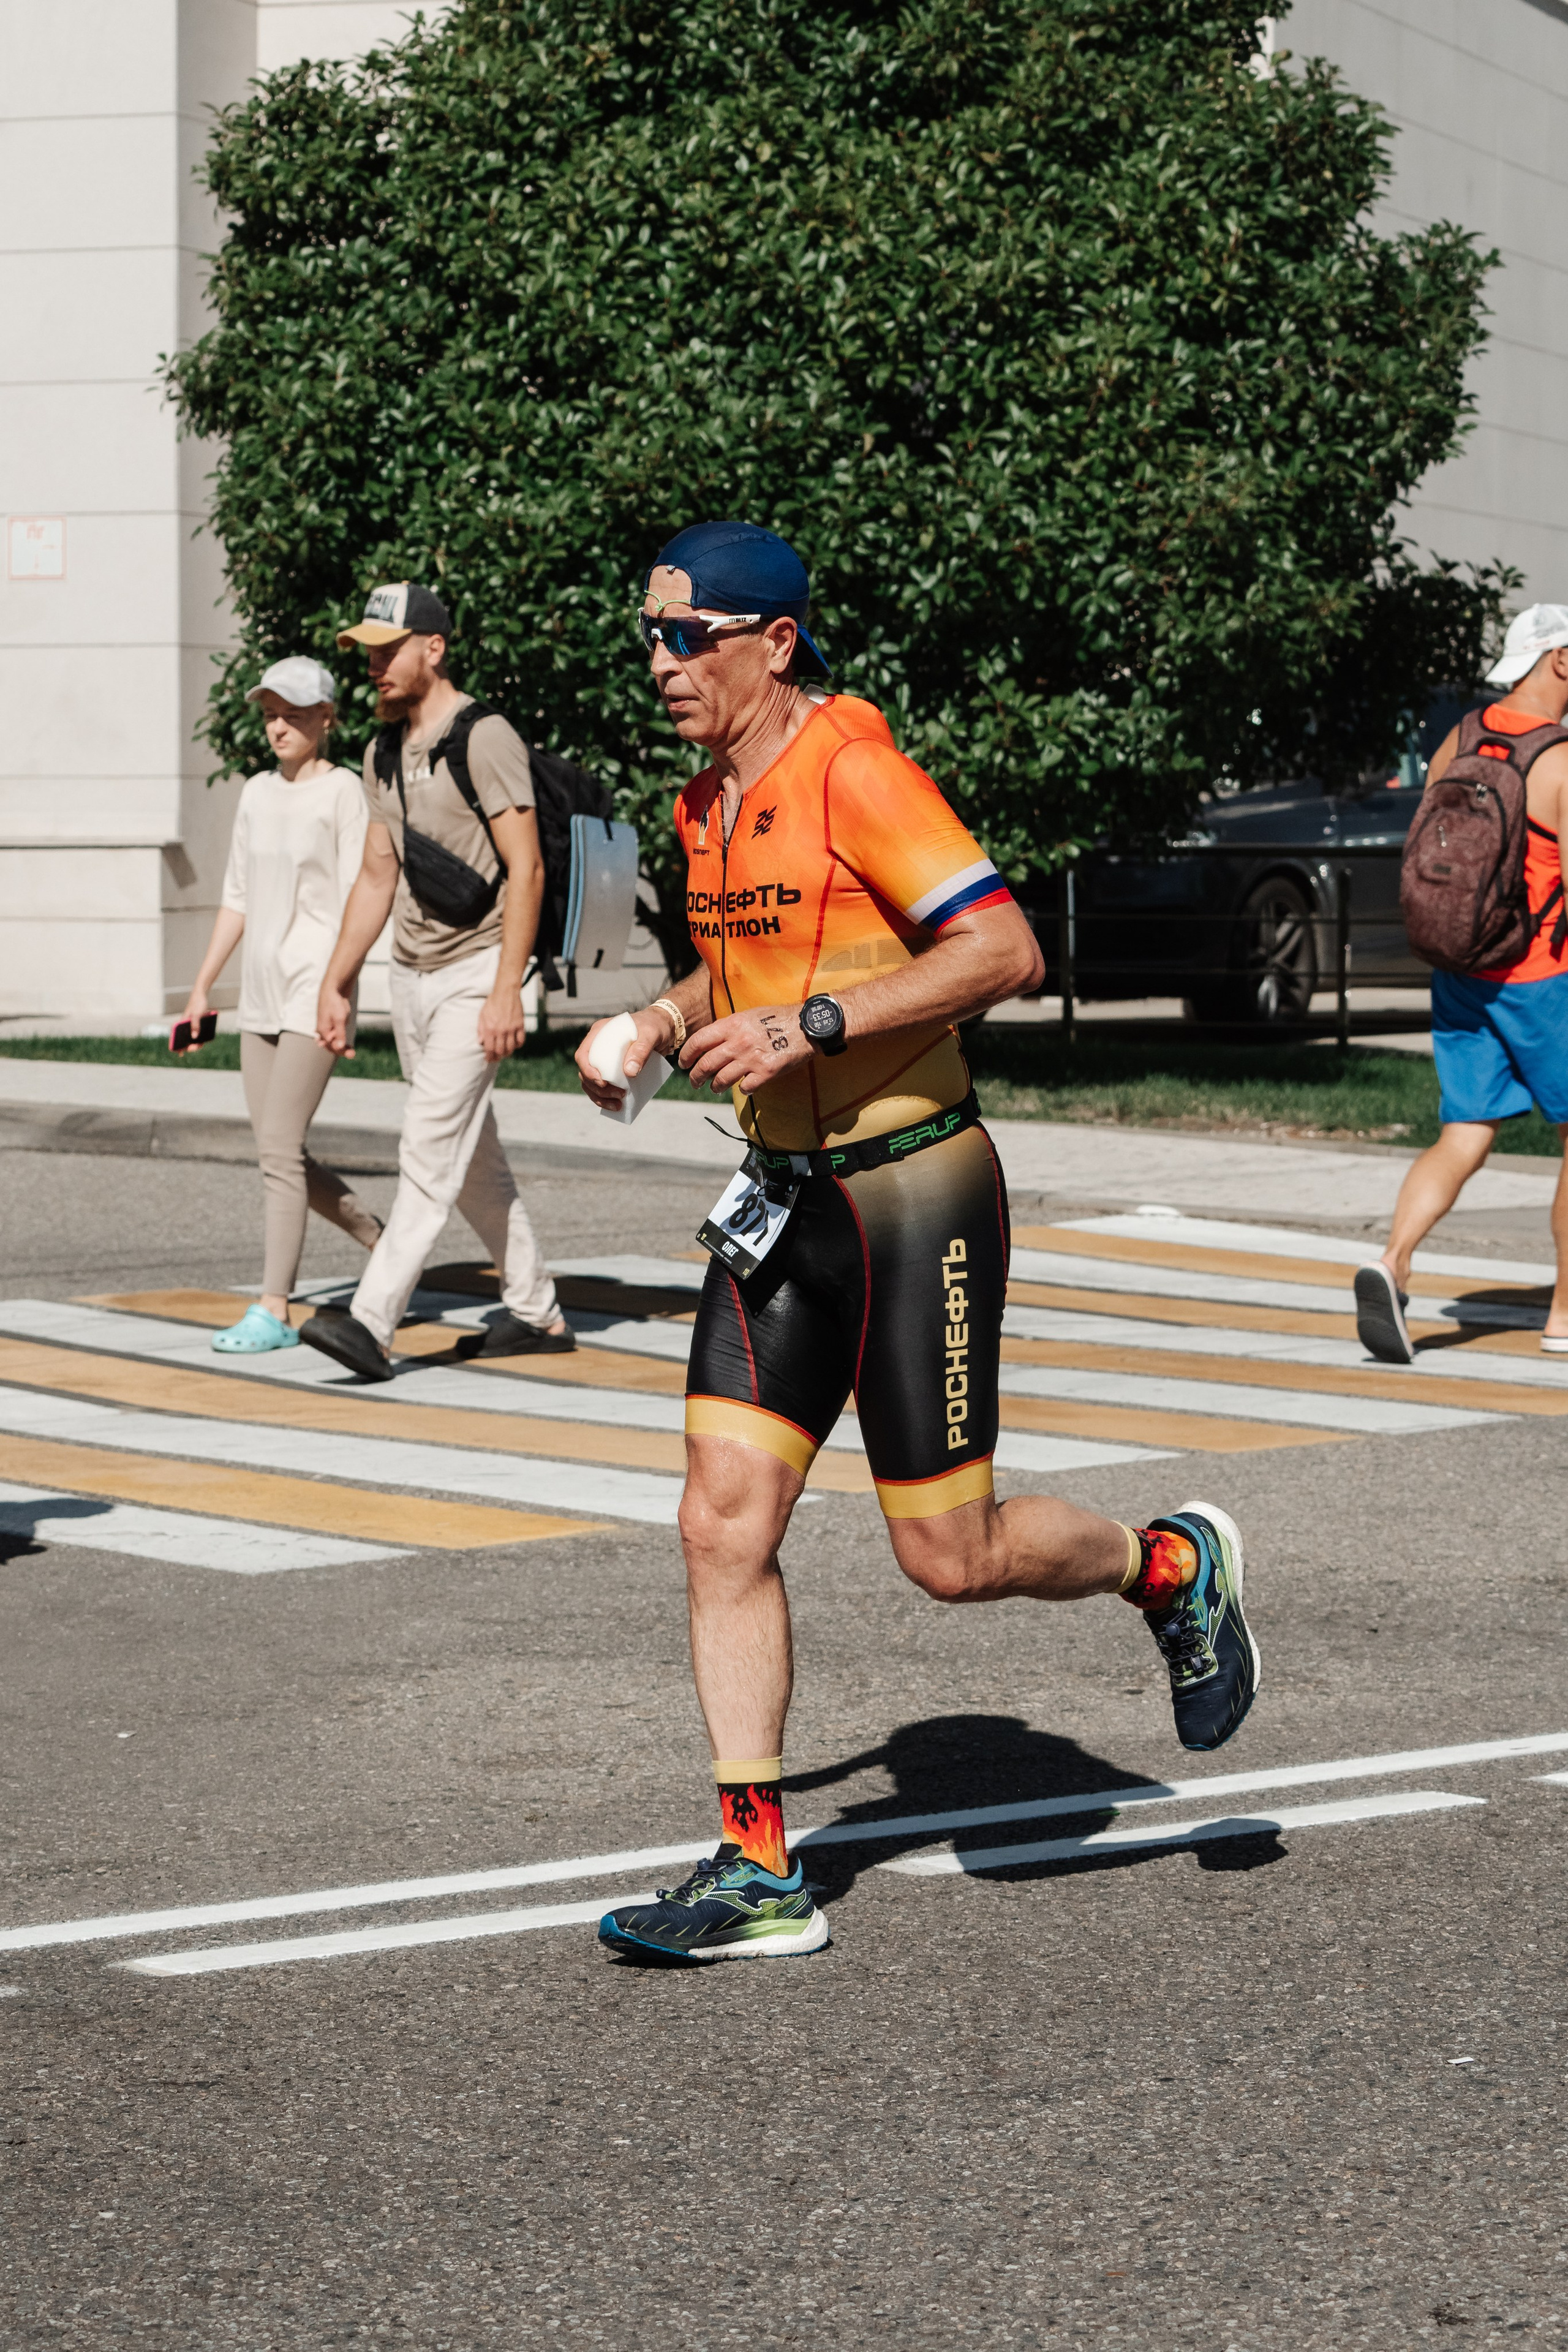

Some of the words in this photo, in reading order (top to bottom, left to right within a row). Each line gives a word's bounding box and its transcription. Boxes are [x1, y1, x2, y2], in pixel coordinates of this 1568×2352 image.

[687, 883, 802, 914] ОСНЕФТЬ
[665, 1001, 678, 1014] SOCHI
[760, 1014, 788, 1051] 871
[729, 1193, 769, 1247] 871
[722, 1241, 739, 1257] ОЛЕГ
[942, 1238, 969, 1450] РОСНЕФТЬ
